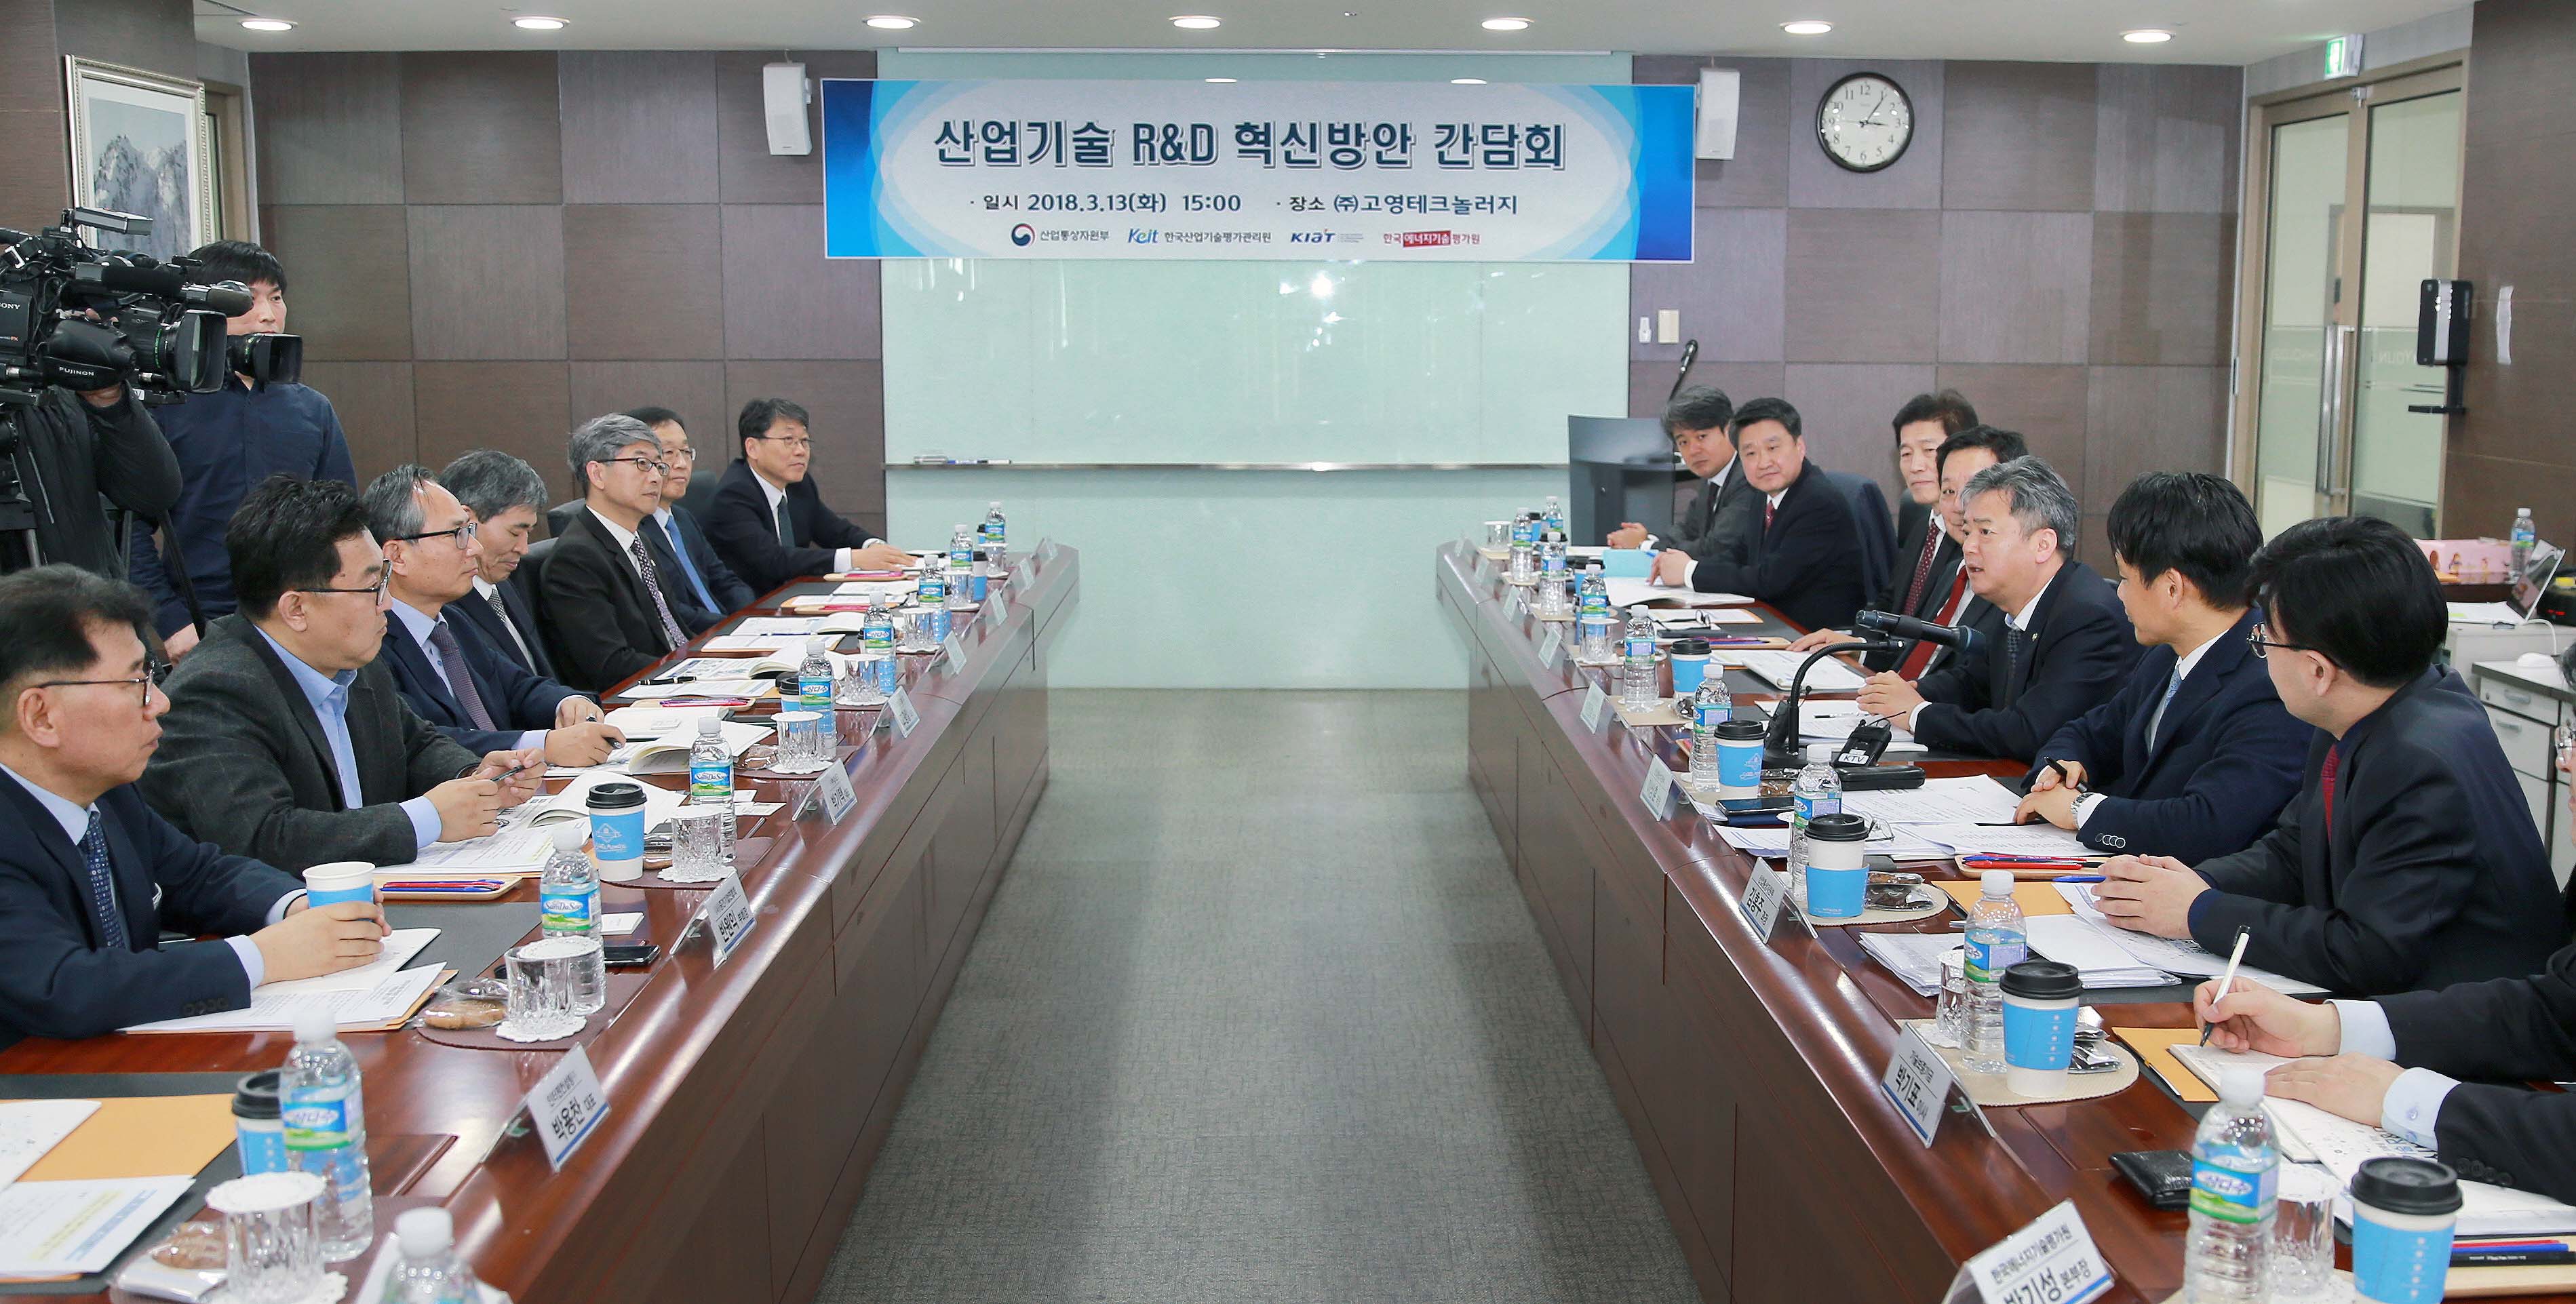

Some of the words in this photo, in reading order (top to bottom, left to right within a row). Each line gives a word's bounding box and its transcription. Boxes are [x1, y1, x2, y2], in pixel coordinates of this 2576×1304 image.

[933, 119, 1114, 168] 산업기술
[1132, 121, 1219, 168] R&D
[1234, 121, 1416, 170] 혁신방안
[1433, 122, 1566, 170] 간담회
[983, 194, 1019, 212] 일시
[1027, 193, 1167, 214] 2018.3.13(화)
[1182, 194, 1242, 212] 15:00
[1289, 195, 1325, 212] 장소
[1040, 229, 1110, 242] 산업통상자원부
[1165, 231, 1272, 244] 한국산업기술평가관리원
[59, 366, 95, 376] FUJINON
[1843, 754, 1865, 762] KTV
[1895, 1063, 1921, 1107] 박기표
[551, 1096, 586, 1141] 박용찬
[583, 1091, 597, 1111] 대표
[2058, 1257, 2091, 1290] 본부장
